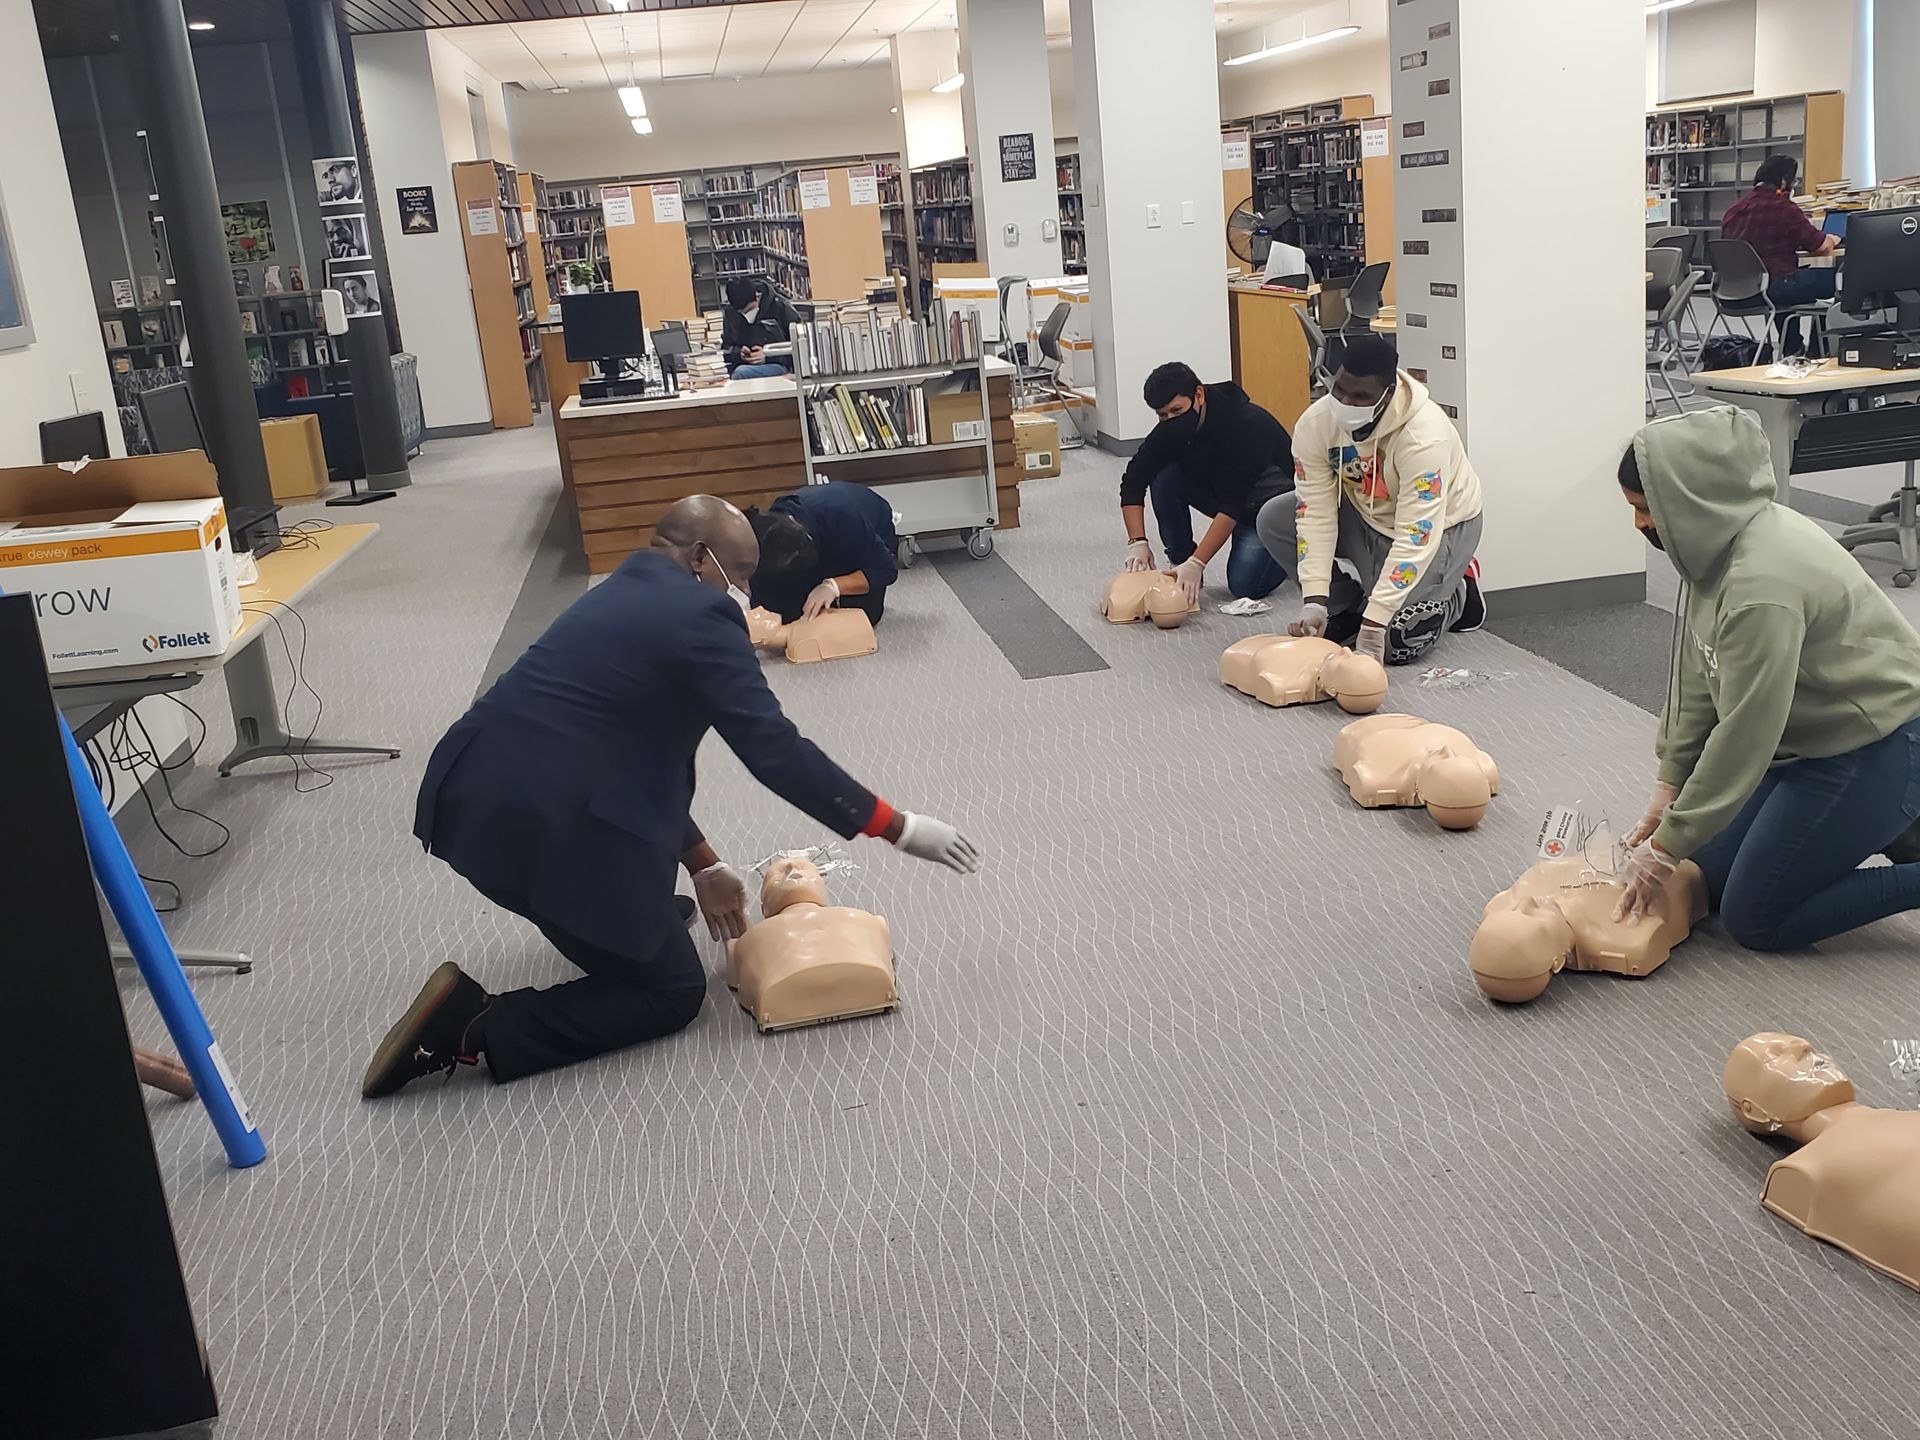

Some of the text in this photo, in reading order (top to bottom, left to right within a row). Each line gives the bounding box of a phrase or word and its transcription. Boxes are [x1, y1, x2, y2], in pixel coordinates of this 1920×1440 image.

[402, 190, 427, 198] BOOKS
[0, 543, 102, 561] rue dewey pack
[158, 632, 211, 649] Follett
[52, 648, 119, 659] FollettLearning.com
